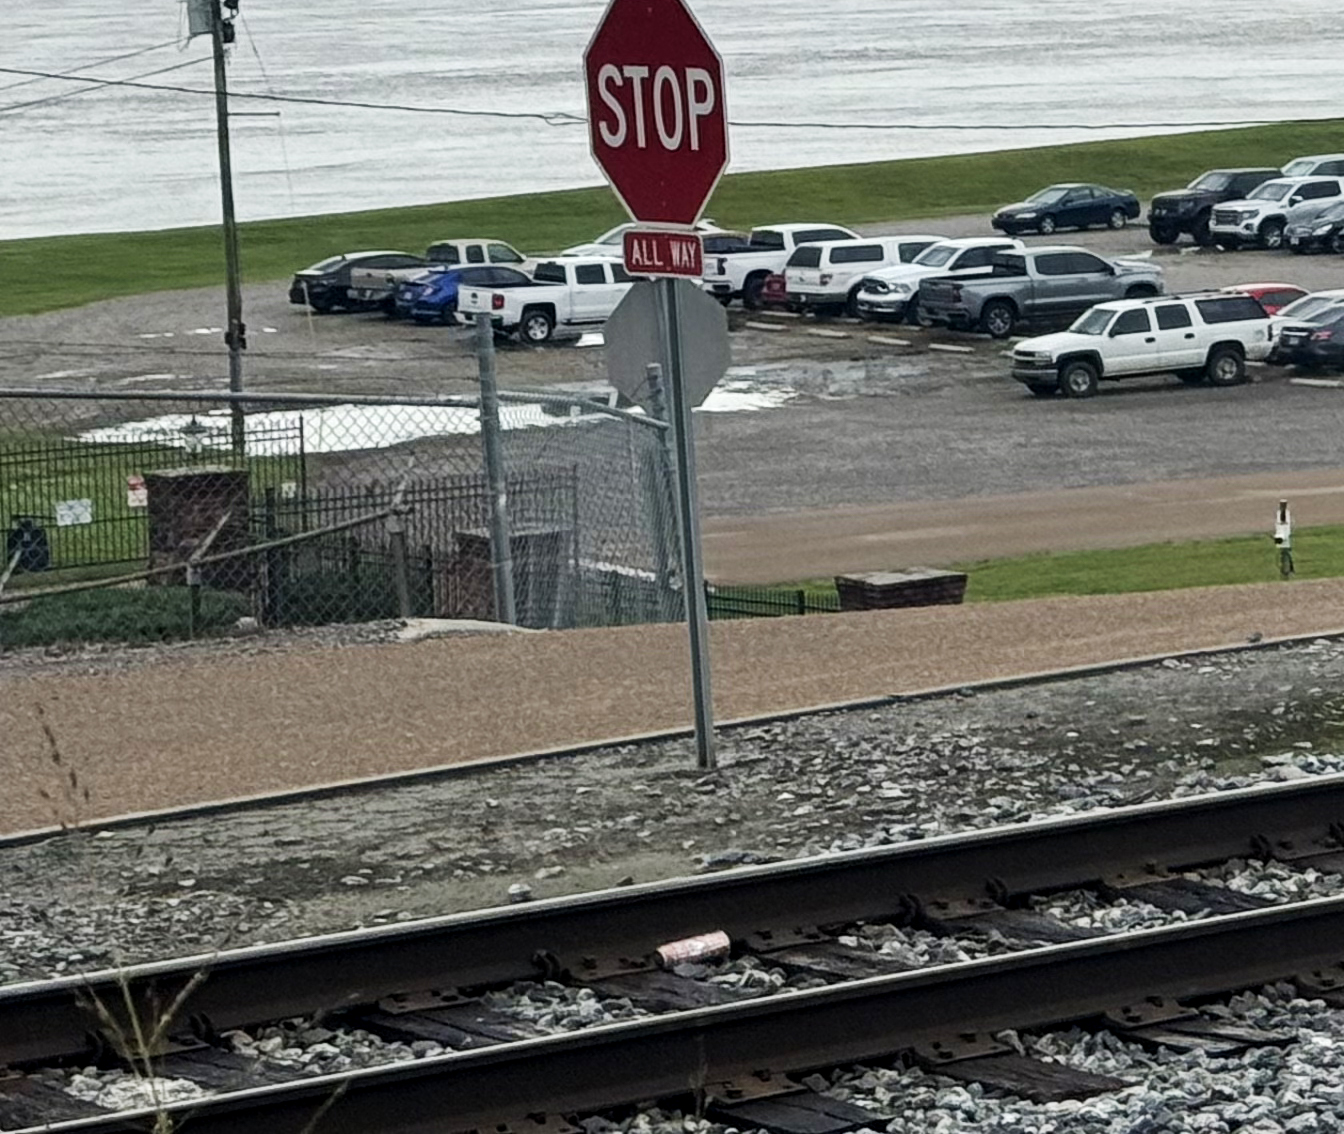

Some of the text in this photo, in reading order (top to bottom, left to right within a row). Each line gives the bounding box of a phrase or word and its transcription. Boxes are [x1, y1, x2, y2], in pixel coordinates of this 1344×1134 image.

[598, 64, 715, 151] STOP
[632, 238, 696, 268] ALL WAY
